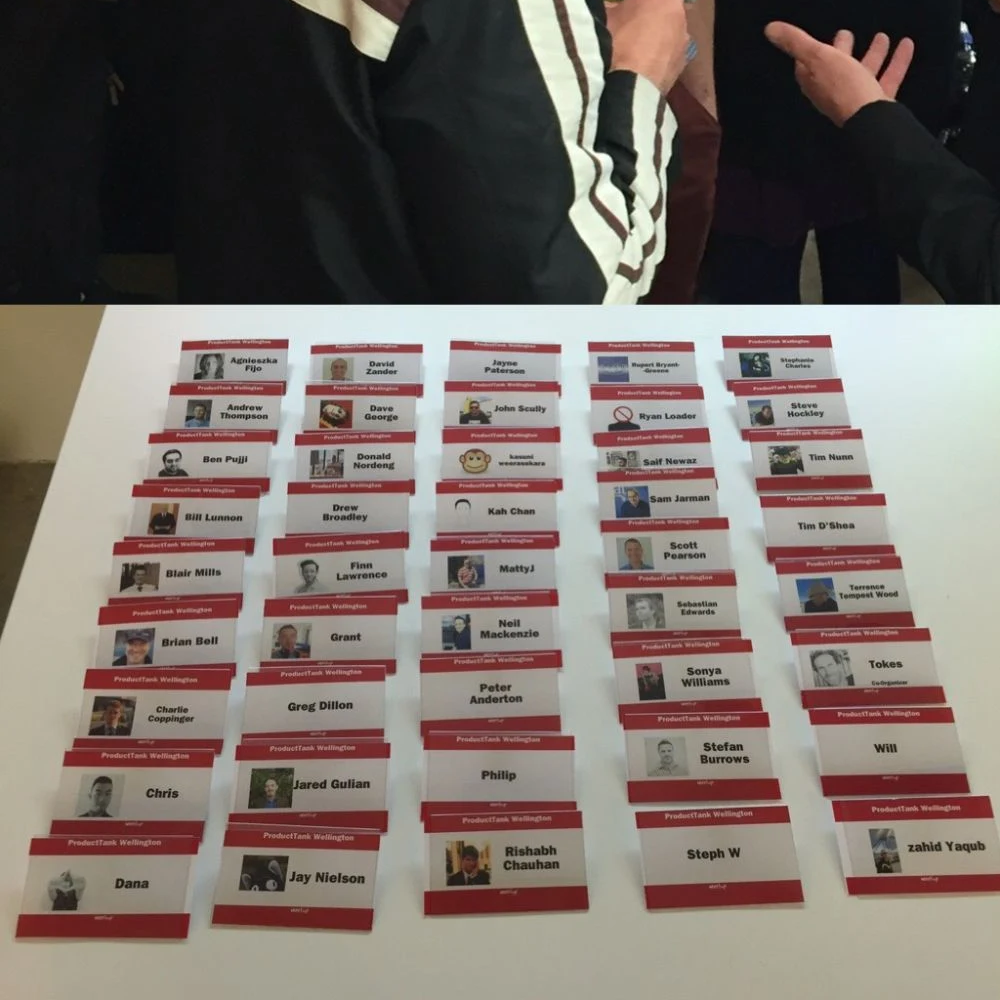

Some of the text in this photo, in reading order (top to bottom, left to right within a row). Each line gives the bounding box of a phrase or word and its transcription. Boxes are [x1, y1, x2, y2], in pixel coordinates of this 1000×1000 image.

[492, 359, 518, 367] Jayne
[245, 365, 262, 373] Fijo
[518, 405, 547, 414] Scully
[791, 402, 818, 410] Steve
[220, 412, 269, 420] Thompson
[364, 413, 399, 422] George
[639, 412, 696, 421] Ryan Loader
[787, 410, 825, 418] Hockley
[225, 456, 248, 464] Pujji
[808, 453, 854, 461] Tim Nunn
[353, 462, 395, 470] Nordeng
[643, 458, 663, 466] Saif
[649, 494, 710, 504] Sam Jarman
[332, 504, 359, 512] Drew
[487, 507, 536, 516] Kah Chan
[184, 513, 243, 522] Bill Lunnon
[322, 513, 368, 522] Broadley
[797, 521, 856, 530] Tim D'Shea
[669, 541, 698, 550] Scott
[663, 551, 707, 560] Pearson
[350, 562, 373, 570] Finn
[165, 568, 222, 578] Blair Mills
[336, 572, 388, 581] Lawrence
[839, 591, 899, 600] Tempest Wood
[681, 608, 716, 616] Edwards
[498, 619, 521, 628] Neil
[330, 632, 362, 642] Grant
[480, 630, 540, 639] Mackenzie
[161, 636, 218, 647] Brian Bell
[868, 659, 904, 669] Tokes
[686, 667, 722, 677] Sonya
[681, 677, 731, 688] Williams
[479, 683, 512, 693] Peter
[469, 694, 523, 705] Anderton
[156, 705, 189, 714] Charlie
[287, 700, 353, 713] Greg Dillon
[147, 714, 195, 724] Coppinger
[703, 742, 744, 752] Stefan
[873, 743, 898, 753] Will
[700, 754, 750, 765] Burrows
[481, 770, 517, 782] Philip
[293, 779, 371, 790] Jared Gulian
[146, 788, 179, 799] Chris
[505, 845, 557, 857] Rishabh
[907, 841, 986, 853] zahid Yaqub
[686, 847, 741, 861] Steph W
[503, 859, 560, 871] Chauhan
[289, 871, 365, 885] Jay Nielson
[114, 878, 149, 889] Dana
